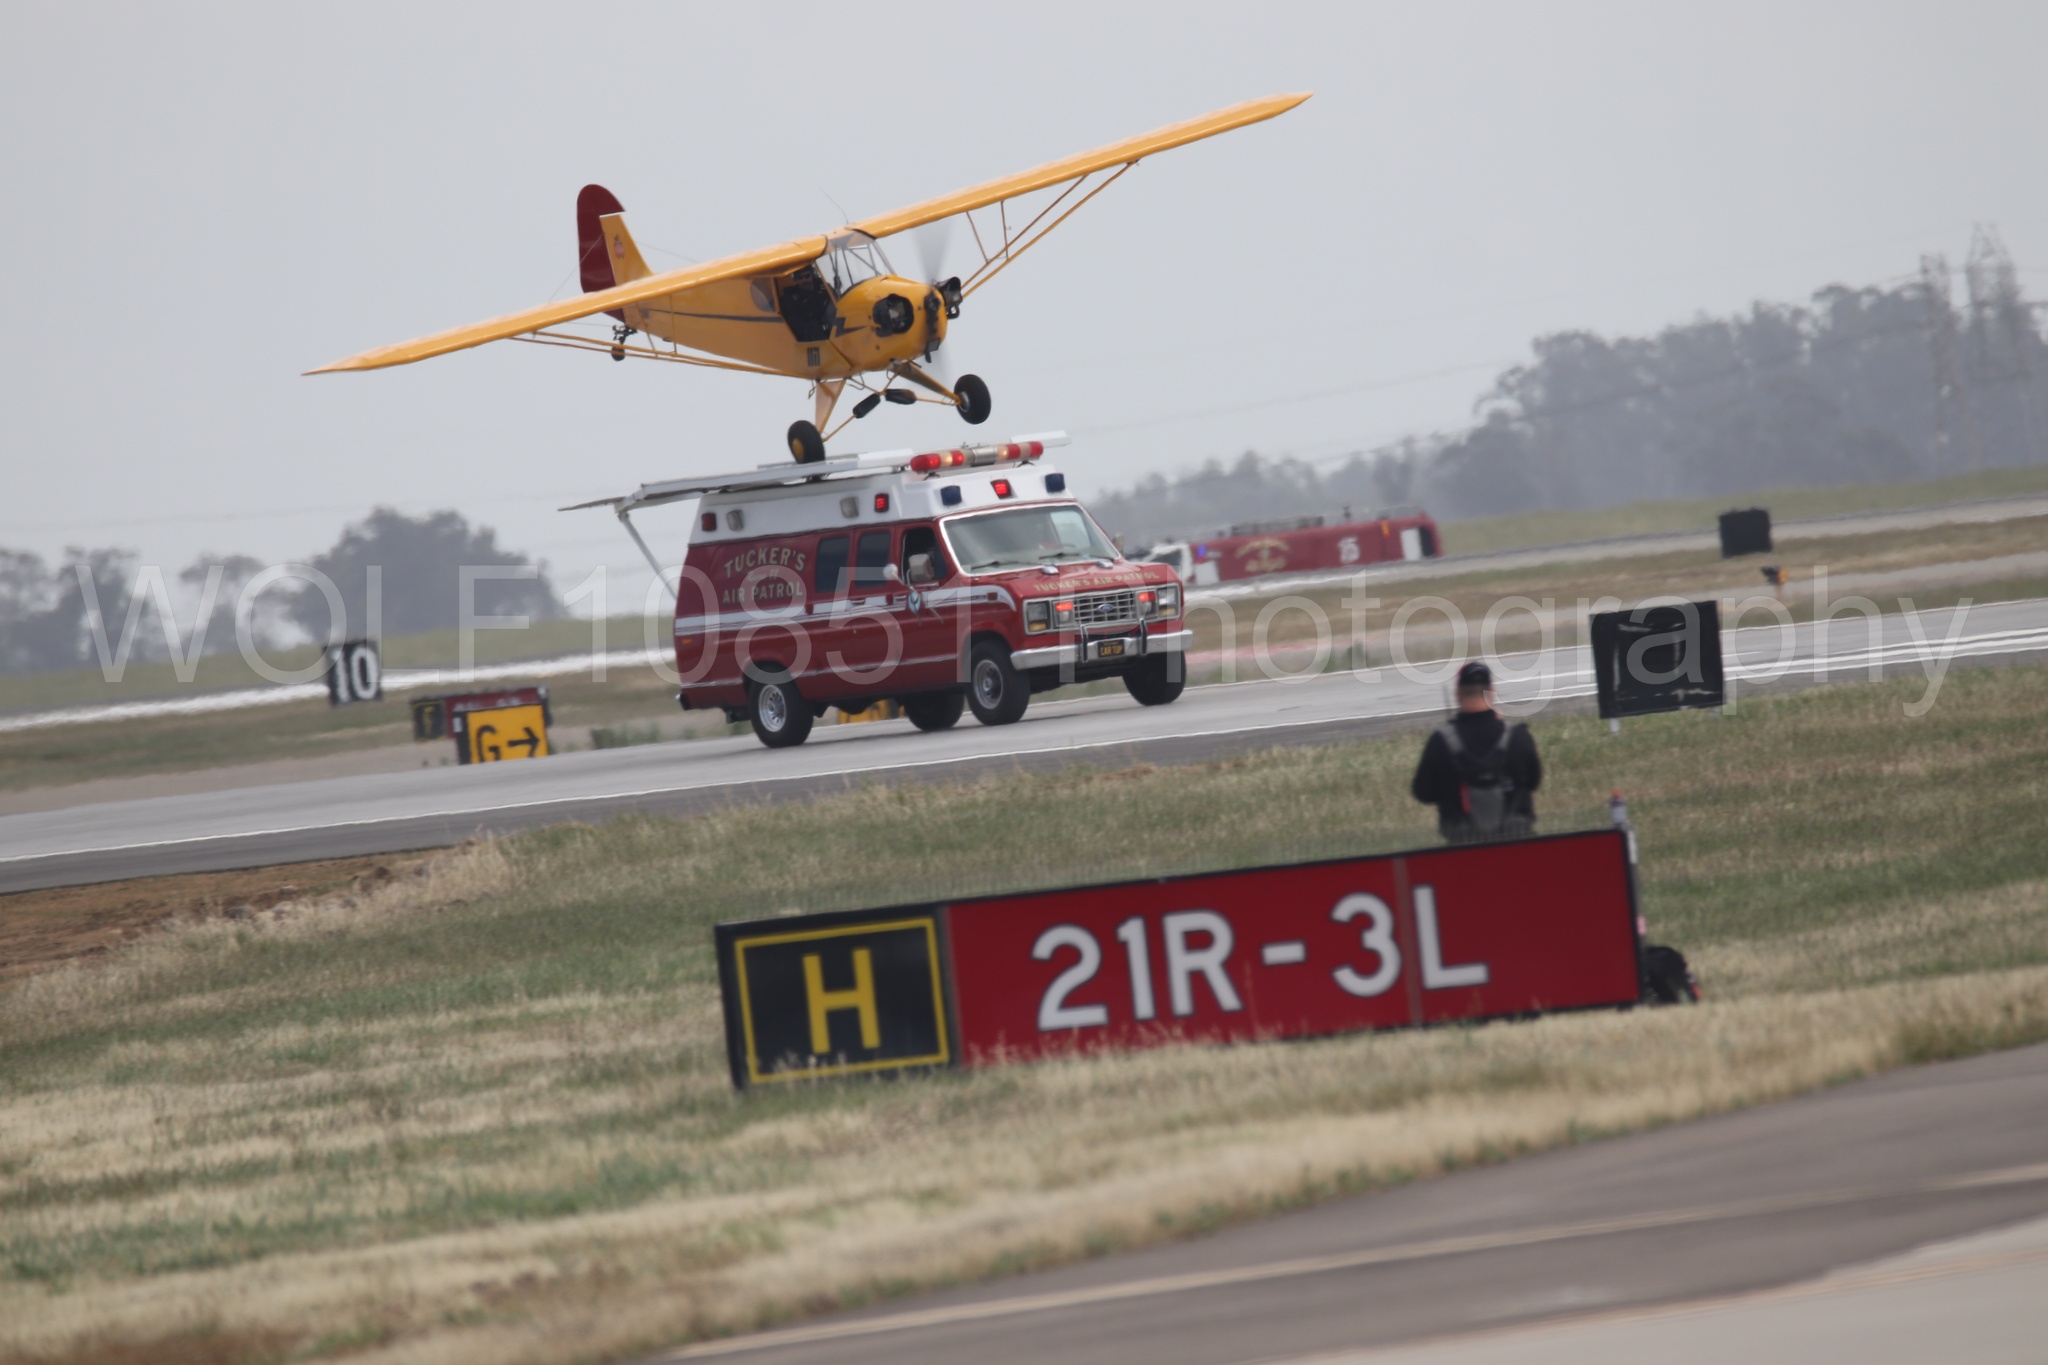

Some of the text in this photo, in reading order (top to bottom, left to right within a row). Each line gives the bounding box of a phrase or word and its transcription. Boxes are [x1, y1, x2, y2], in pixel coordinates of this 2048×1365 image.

[724, 547, 805, 578] TUCKER'S
[723, 582, 803, 605] AIR PATROL
[1033, 571, 1160, 592] TUCKER'S AIR PATROL
[329, 646, 380, 703] 10
[803, 948, 881, 1053] H
